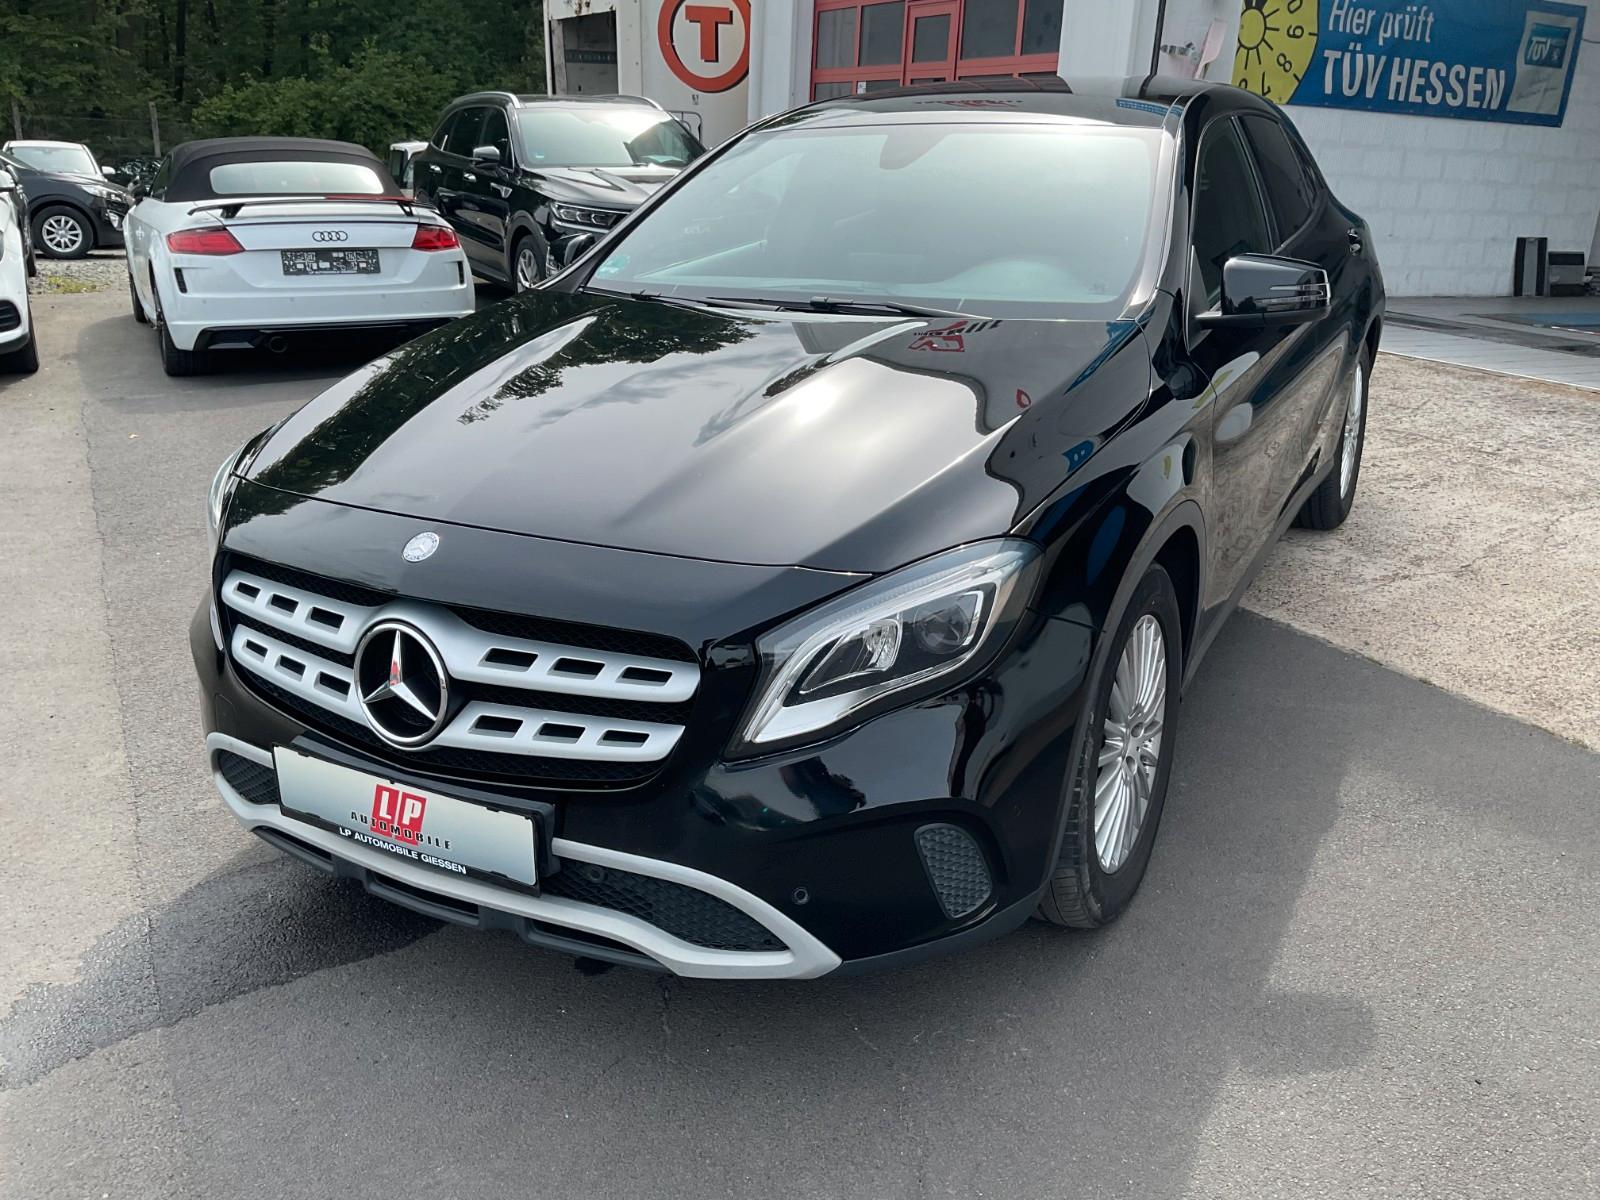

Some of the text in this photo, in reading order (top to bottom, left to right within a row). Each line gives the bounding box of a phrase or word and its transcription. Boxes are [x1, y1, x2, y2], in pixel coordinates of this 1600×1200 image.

[685, 5, 733, 62] T
[1328, 0, 1435, 46] Hier prüft
[1276, 53, 1292, 72] 8
[1323, 42, 1506, 110] TÜV HESSEN
[350, 811, 453, 850] AUTOMOBILE
[379, 790, 422, 825] LP
[339, 827, 467, 875] LP AUTOMOBILE GIESSEN
